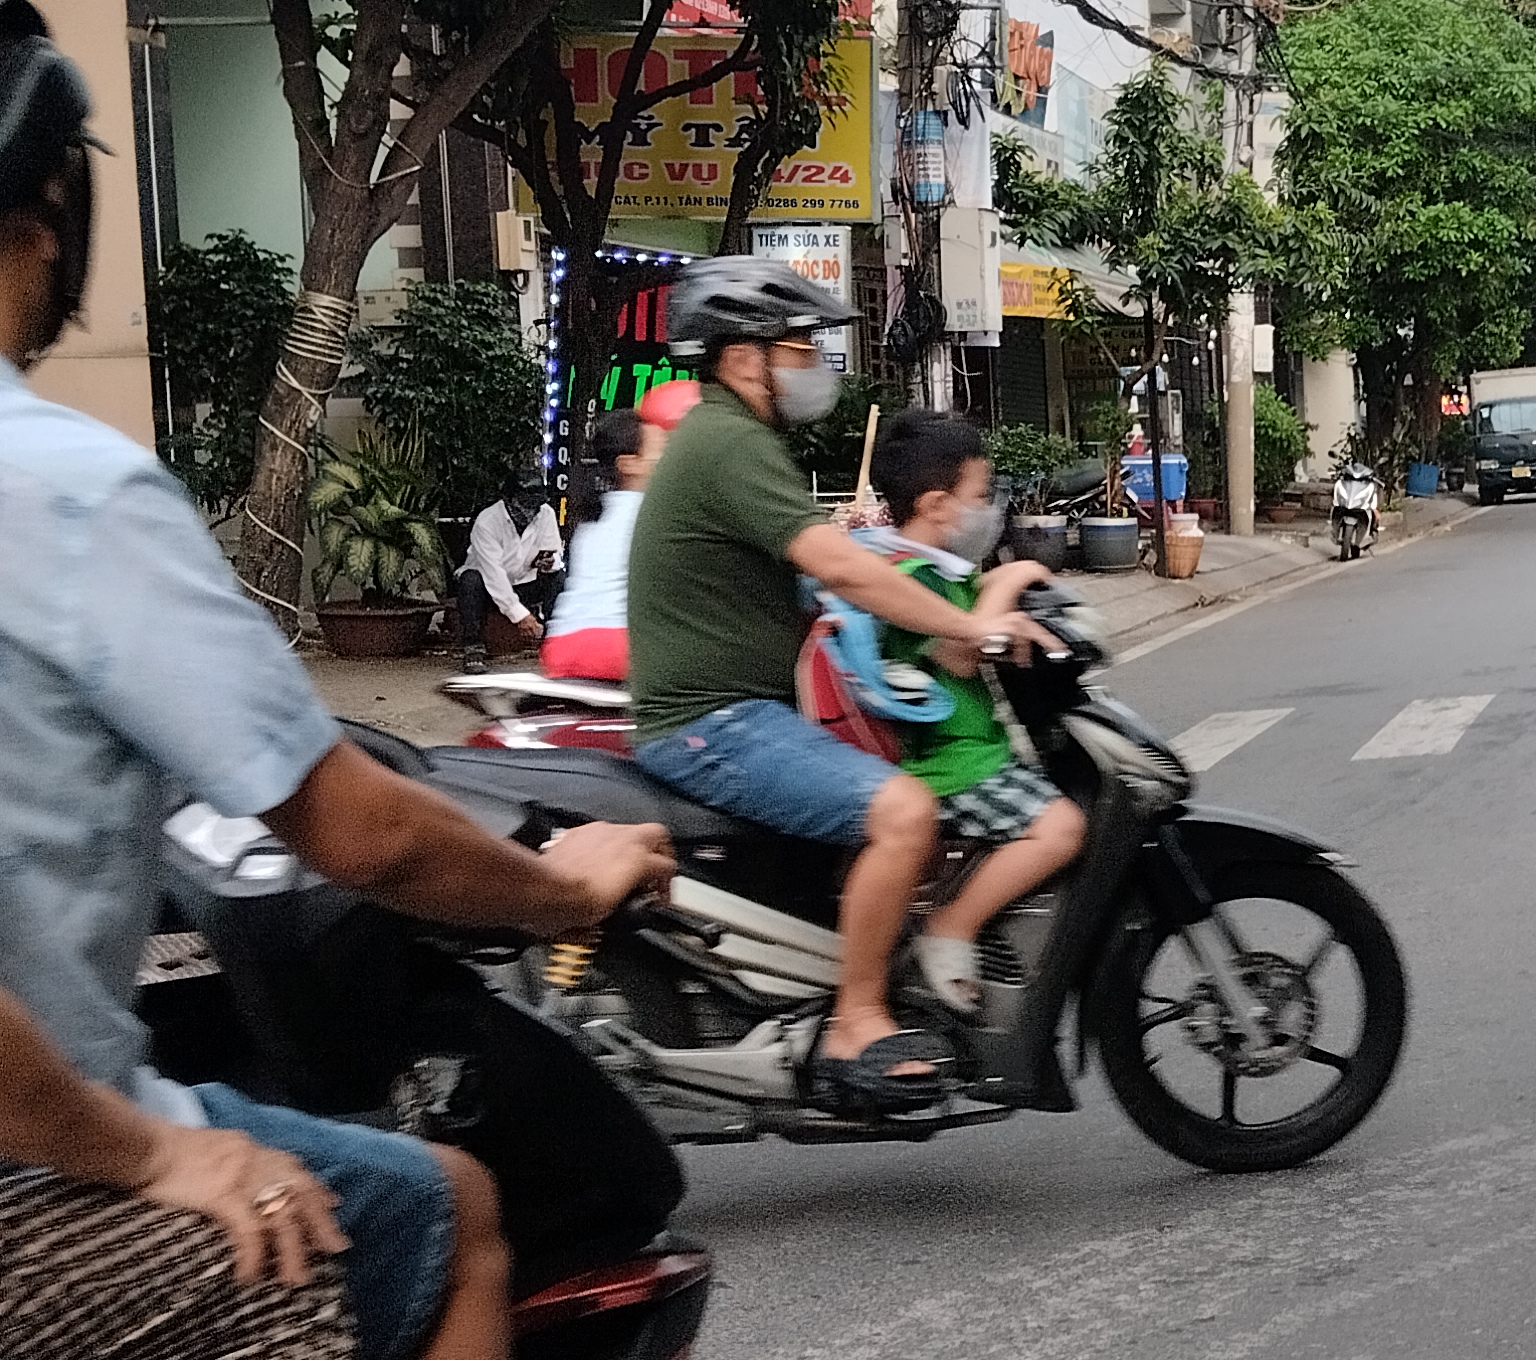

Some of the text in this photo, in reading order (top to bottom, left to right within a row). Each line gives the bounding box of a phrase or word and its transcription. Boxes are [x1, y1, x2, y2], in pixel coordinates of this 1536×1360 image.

[664, 162, 718, 186] VỤ
[643, 195, 674, 208] P.11,
[677, 193, 702, 207] TÂN
[706, 194, 732, 207] BÌN
[767, 198, 797, 208] 0286
[801, 198, 825, 208] 299
[758, 229, 840, 251] TIỆM SỬA XE
[821, 253, 841, 285] ĐỘ
